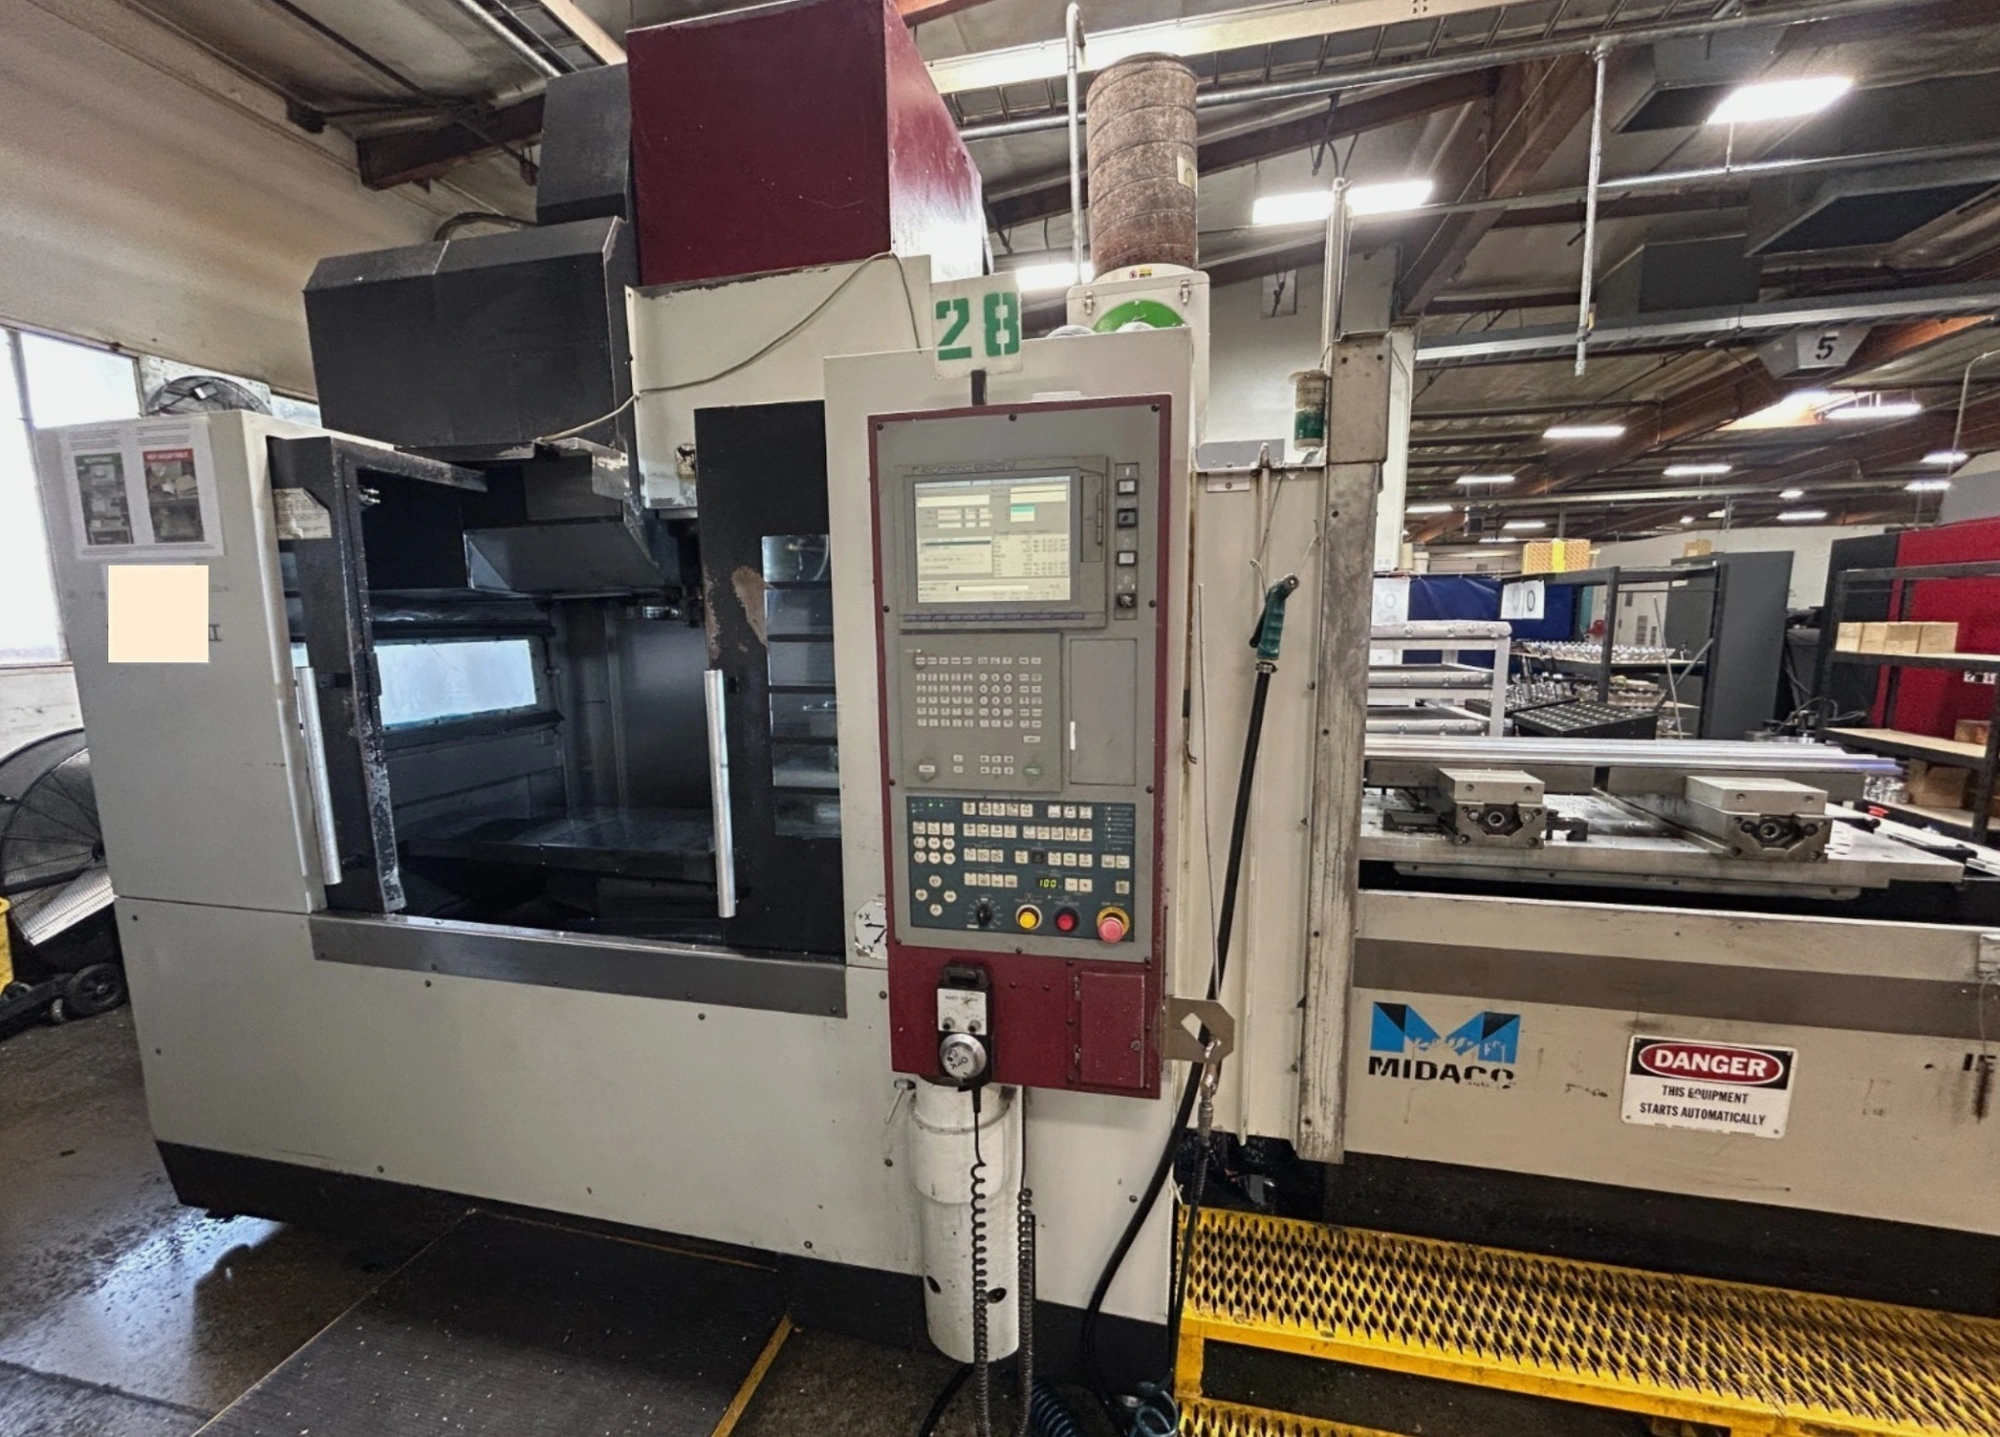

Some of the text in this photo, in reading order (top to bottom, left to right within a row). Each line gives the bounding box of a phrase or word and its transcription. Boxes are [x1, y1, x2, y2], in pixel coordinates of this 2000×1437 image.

[935, 291, 1020, 361] 28
[1815, 336, 1838, 360] 5
[1039, 879, 1057, 888] 100
[1654, 1049, 1768, 1077] DANGER
[1662, 1084, 1685, 1098] THIS
[1639, 1102, 1766, 1126] STARTS AUTOMATICALLY
